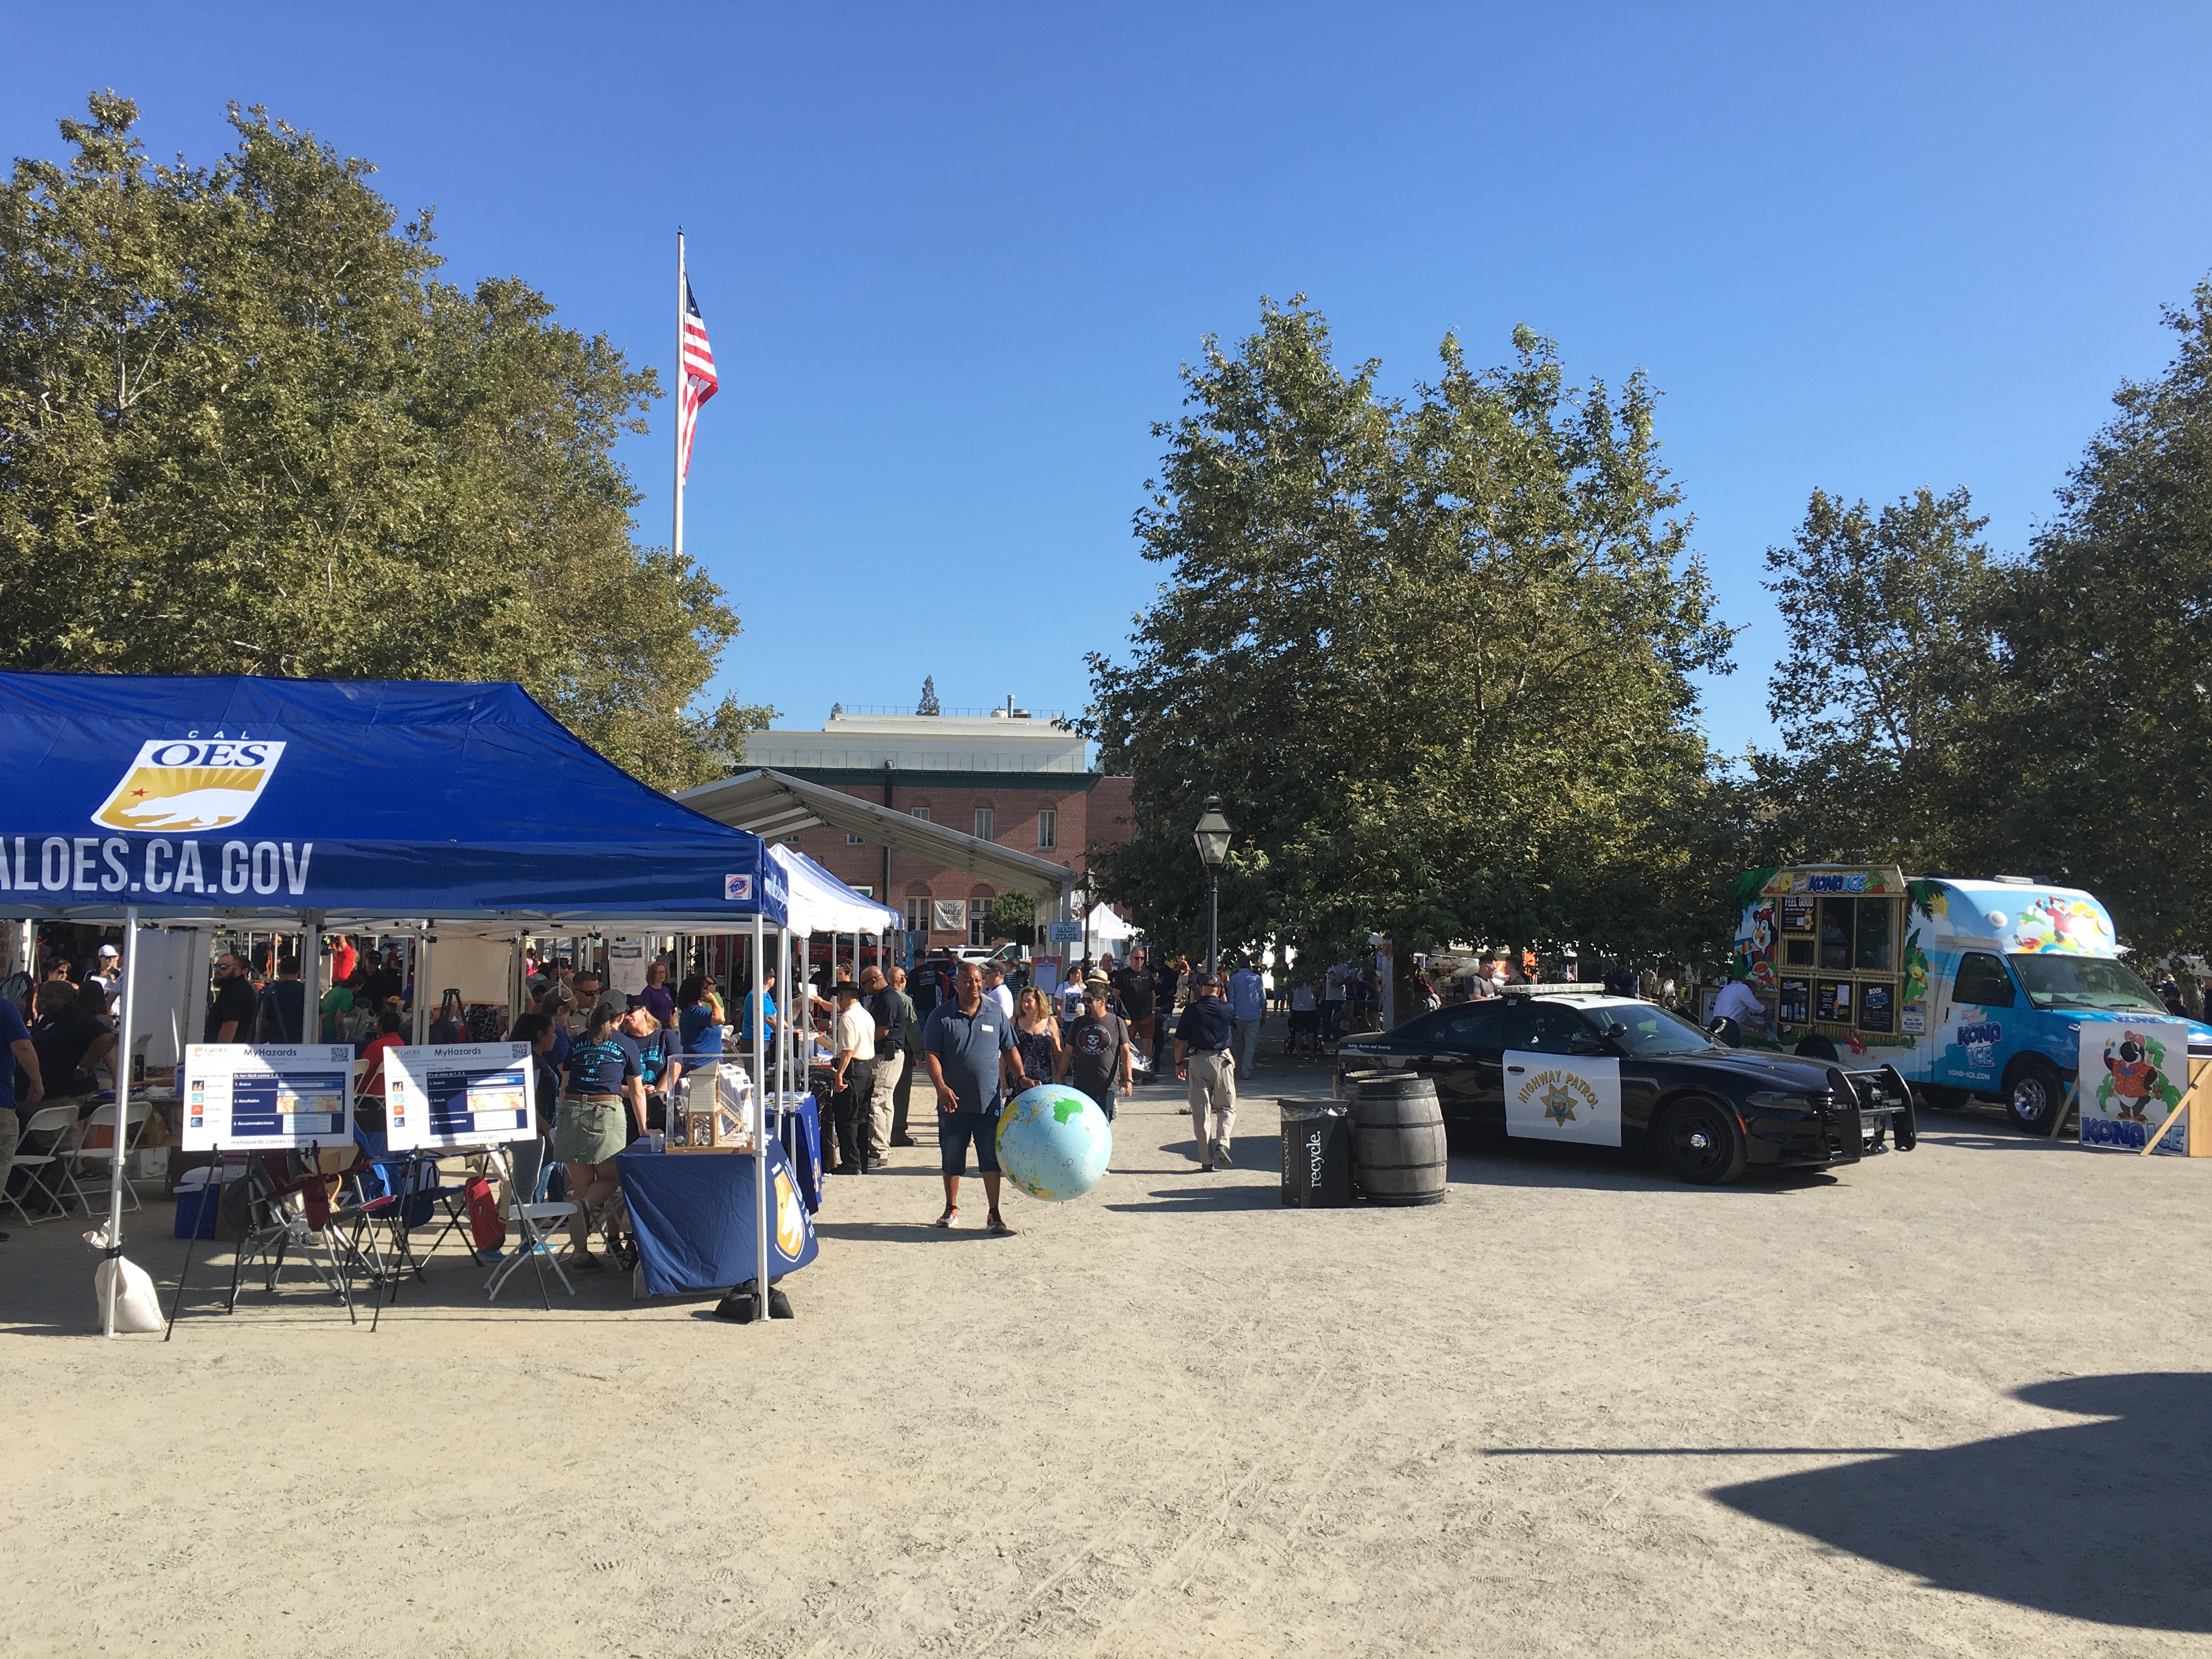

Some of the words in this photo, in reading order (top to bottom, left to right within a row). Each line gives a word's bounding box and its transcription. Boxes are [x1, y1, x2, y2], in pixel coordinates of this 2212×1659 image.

[188, 730, 250, 740] CAL
[151, 743, 268, 767] OES
[1807, 874, 1843, 894] KONA
[1843, 873, 1867, 893] ICE
[1785, 897, 1797, 907] FEEL
[1799, 897, 1814, 907] GOOD
[942, 916, 960, 924] TOURS
[1957, 1022, 2001, 1047] KONA
[572, 1040, 617, 1051] CALIFNIA
[573, 1046, 610, 1055] PREPAREDNESS
[244, 1048, 297, 1058] MyHazards
[435, 1047, 481, 1057] MyHazards
[1967, 1045, 1995, 1069] ICE
[1949, 1070, 1990, 1080] KONA-ICE.COM
[1517, 1070, 1561, 1104] HIGHWAY
[1565, 1072, 1599, 1110] PATROL
[2081, 1117, 2146, 1148] KONA
[431, 1135, 498, 1143] myhazards.caloes.ca.gov
[1306, 1130, 1324, 1188] recycle.
